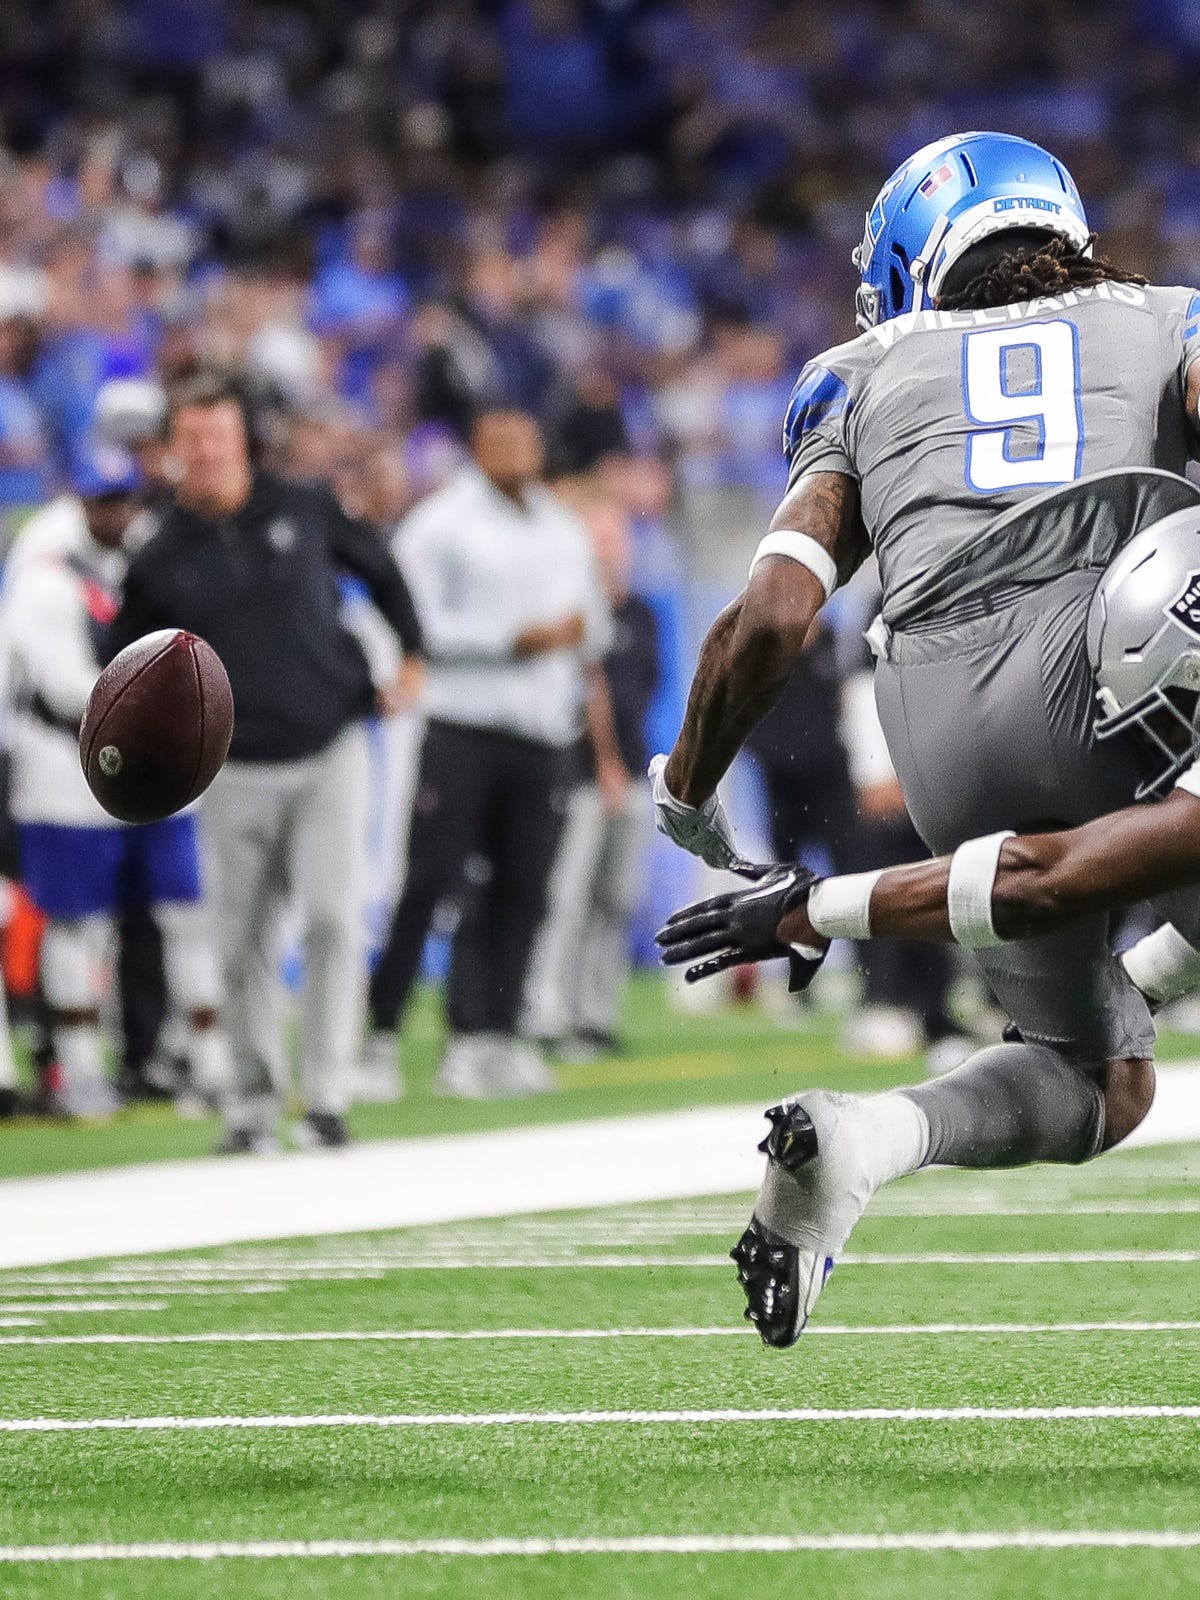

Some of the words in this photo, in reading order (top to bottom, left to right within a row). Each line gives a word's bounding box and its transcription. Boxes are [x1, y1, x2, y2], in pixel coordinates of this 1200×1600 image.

[993, 197, 1062, 215] DETROIT
[868, 279, 1146, 350] WILLIAMS
[962, 318, 1084, 494] 9
